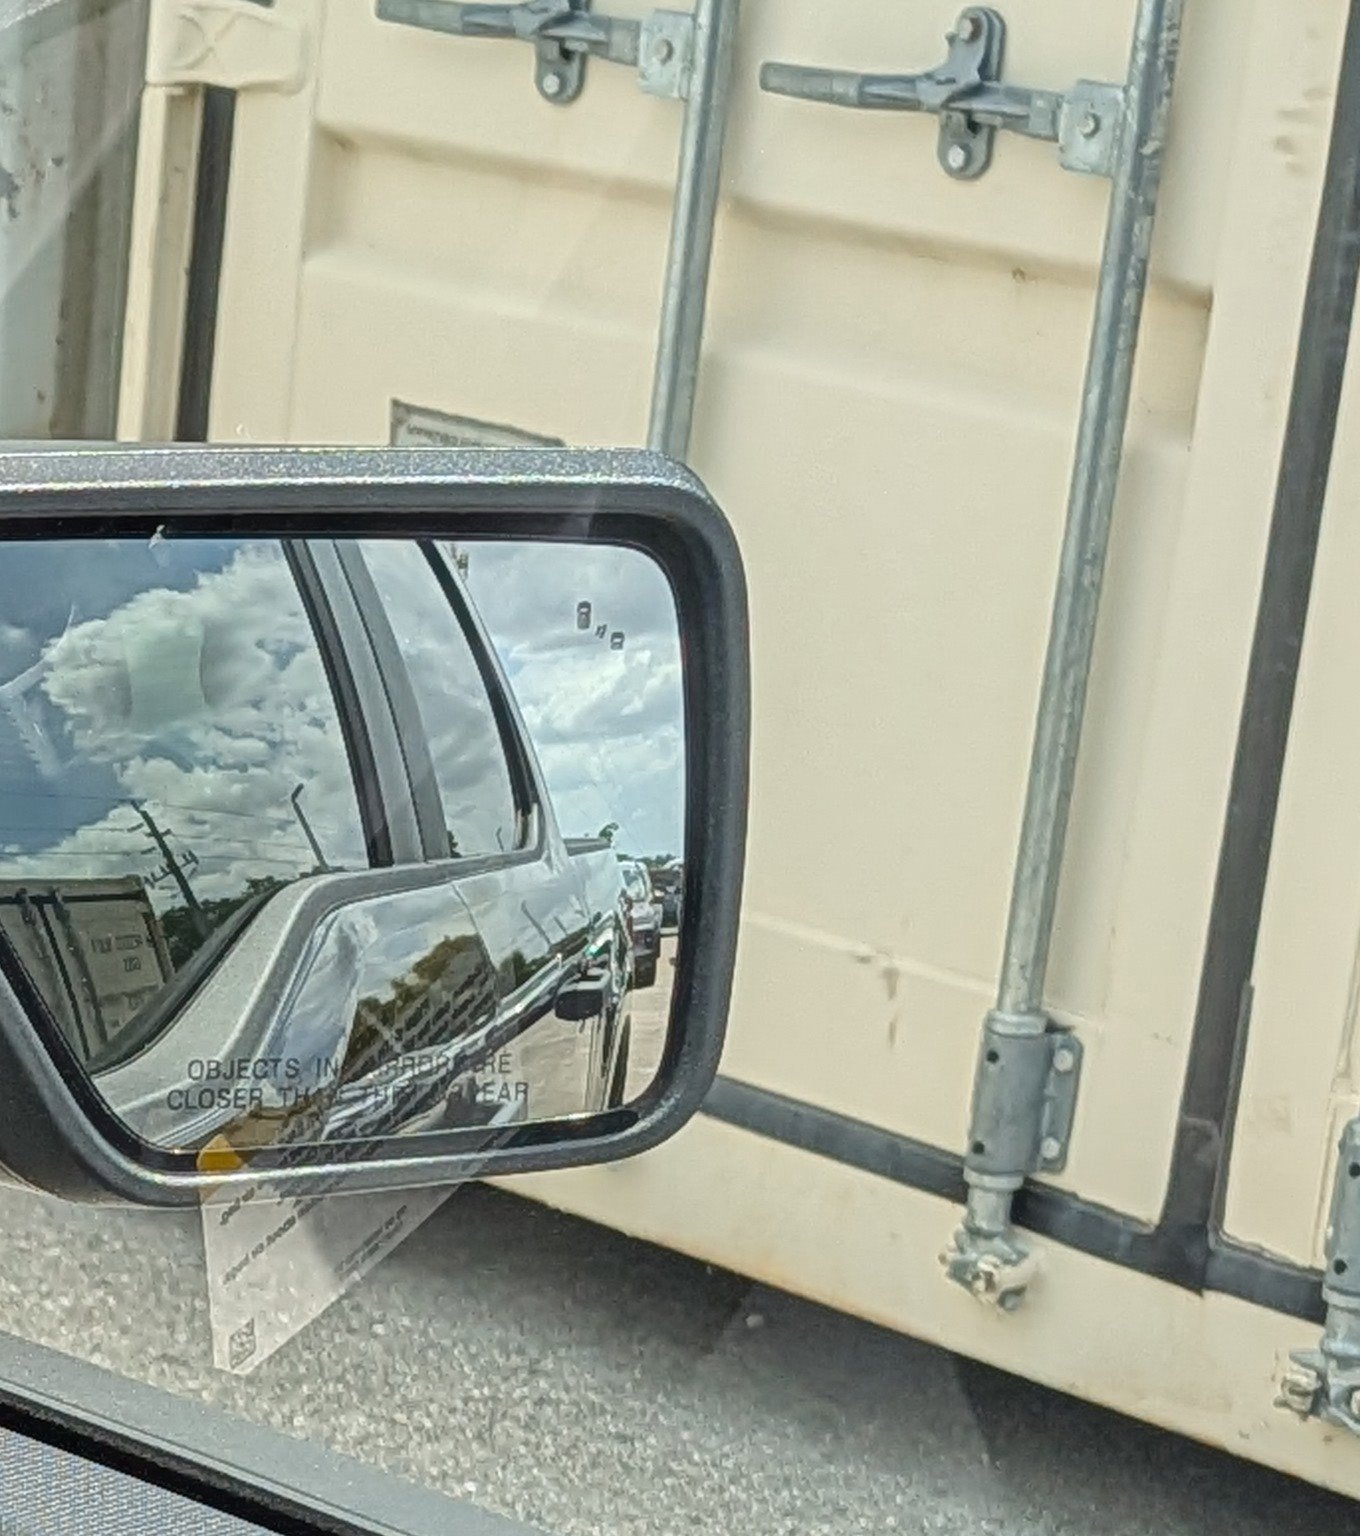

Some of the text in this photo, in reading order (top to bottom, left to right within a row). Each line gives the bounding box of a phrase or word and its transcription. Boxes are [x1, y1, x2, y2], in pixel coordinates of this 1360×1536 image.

[186, 1057, 301, 1082] OBJECTS
[314, 1056, 340, 1078] IN
[166, 1086, 264, 1112] CLOSER
